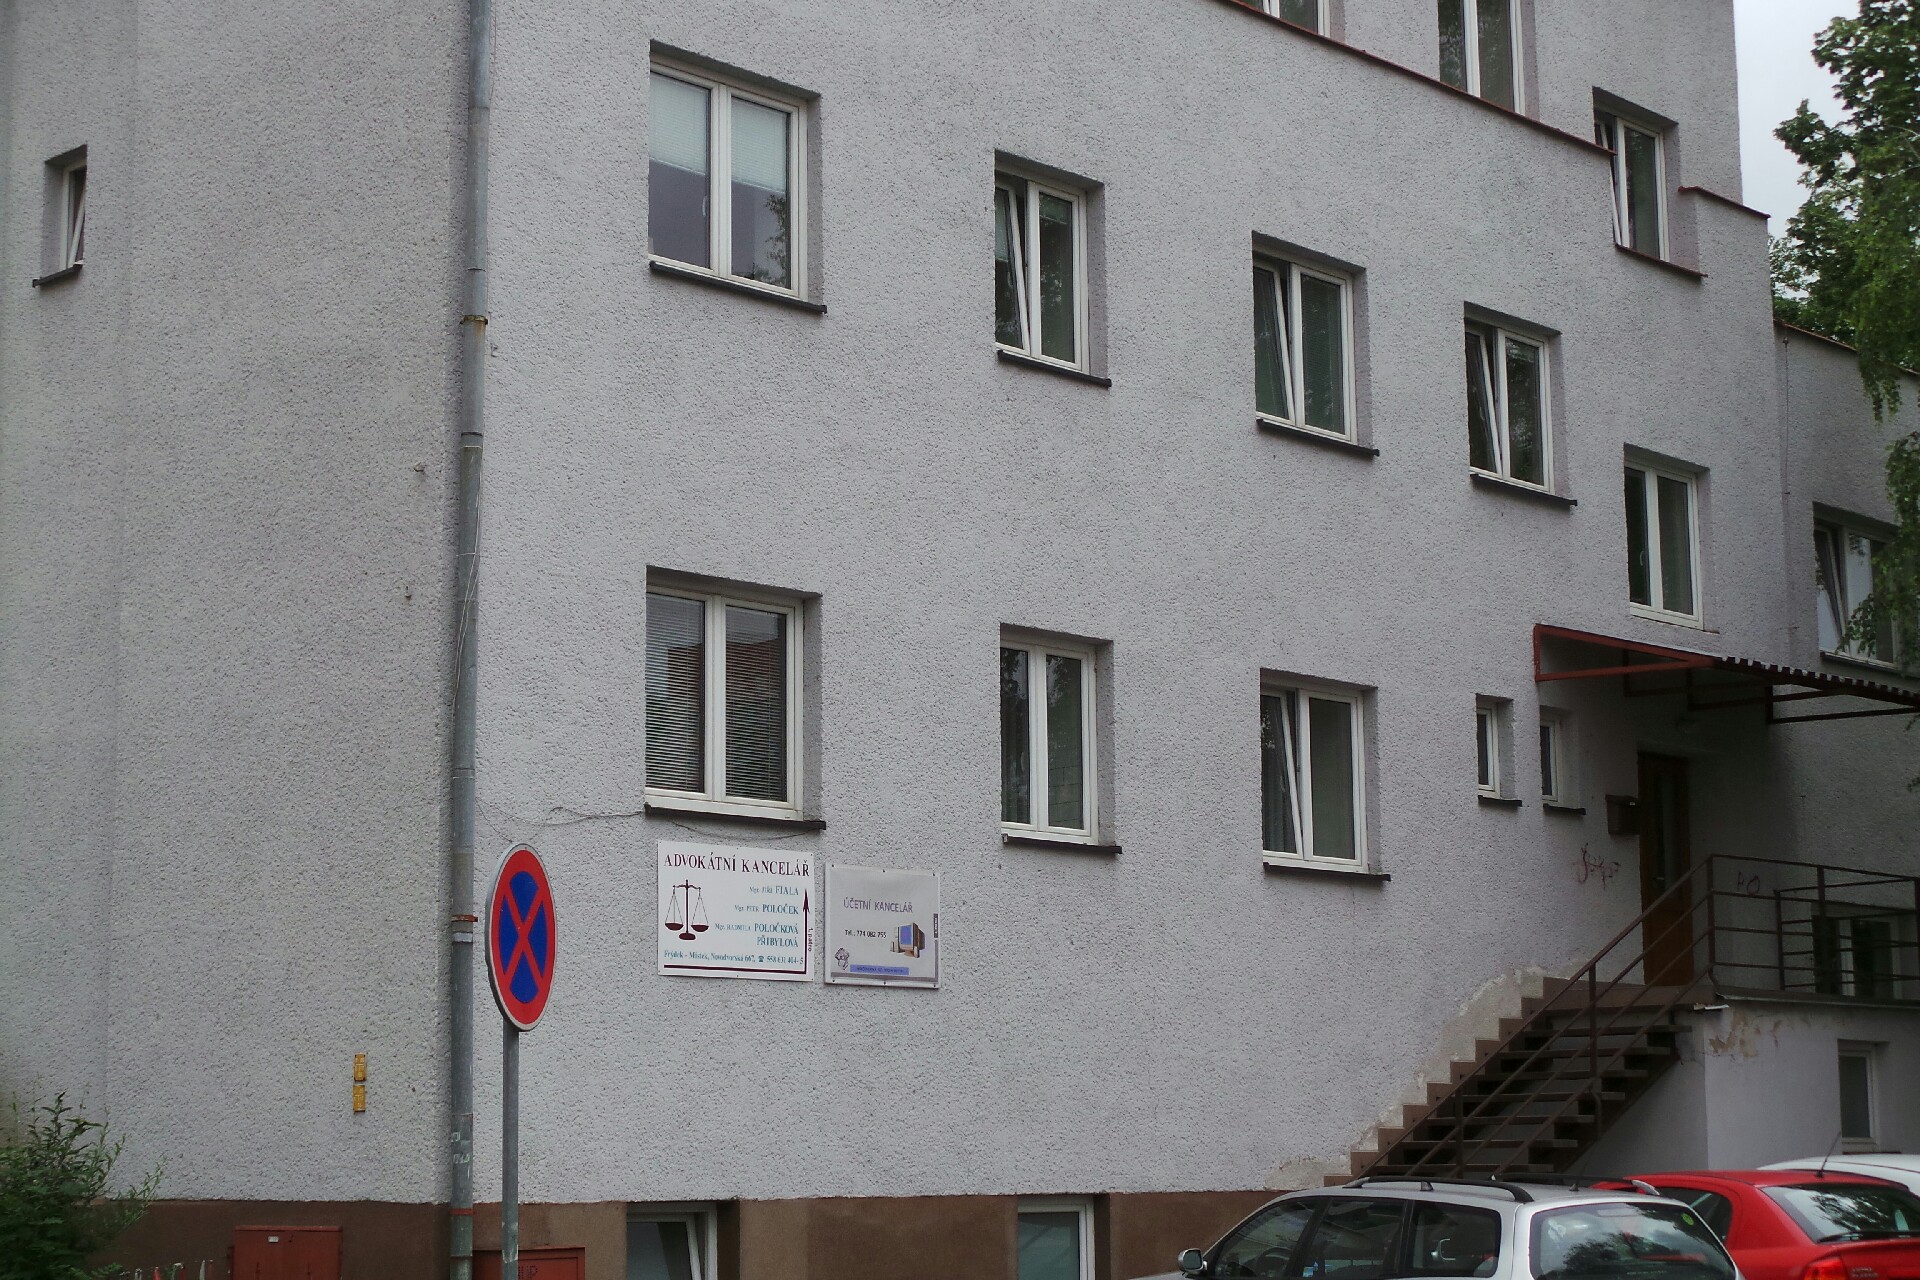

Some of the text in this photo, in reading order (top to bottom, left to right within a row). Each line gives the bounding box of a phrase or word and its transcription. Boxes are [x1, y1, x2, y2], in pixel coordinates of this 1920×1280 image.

[664, 852, 809, 877] ADVOKÁTNÍ KANCELÁŘ
[775, 885, 799, 896] FIALA
[762, 903, 799, 915] POLOČEK
[843, 896, 913, 913] ÚČETNÍ KANCELÁŘ
[754, 922, 799, 935] POLOČKOVÁ
[756, 935, 799, 948] PŘIBYLOVÁ
